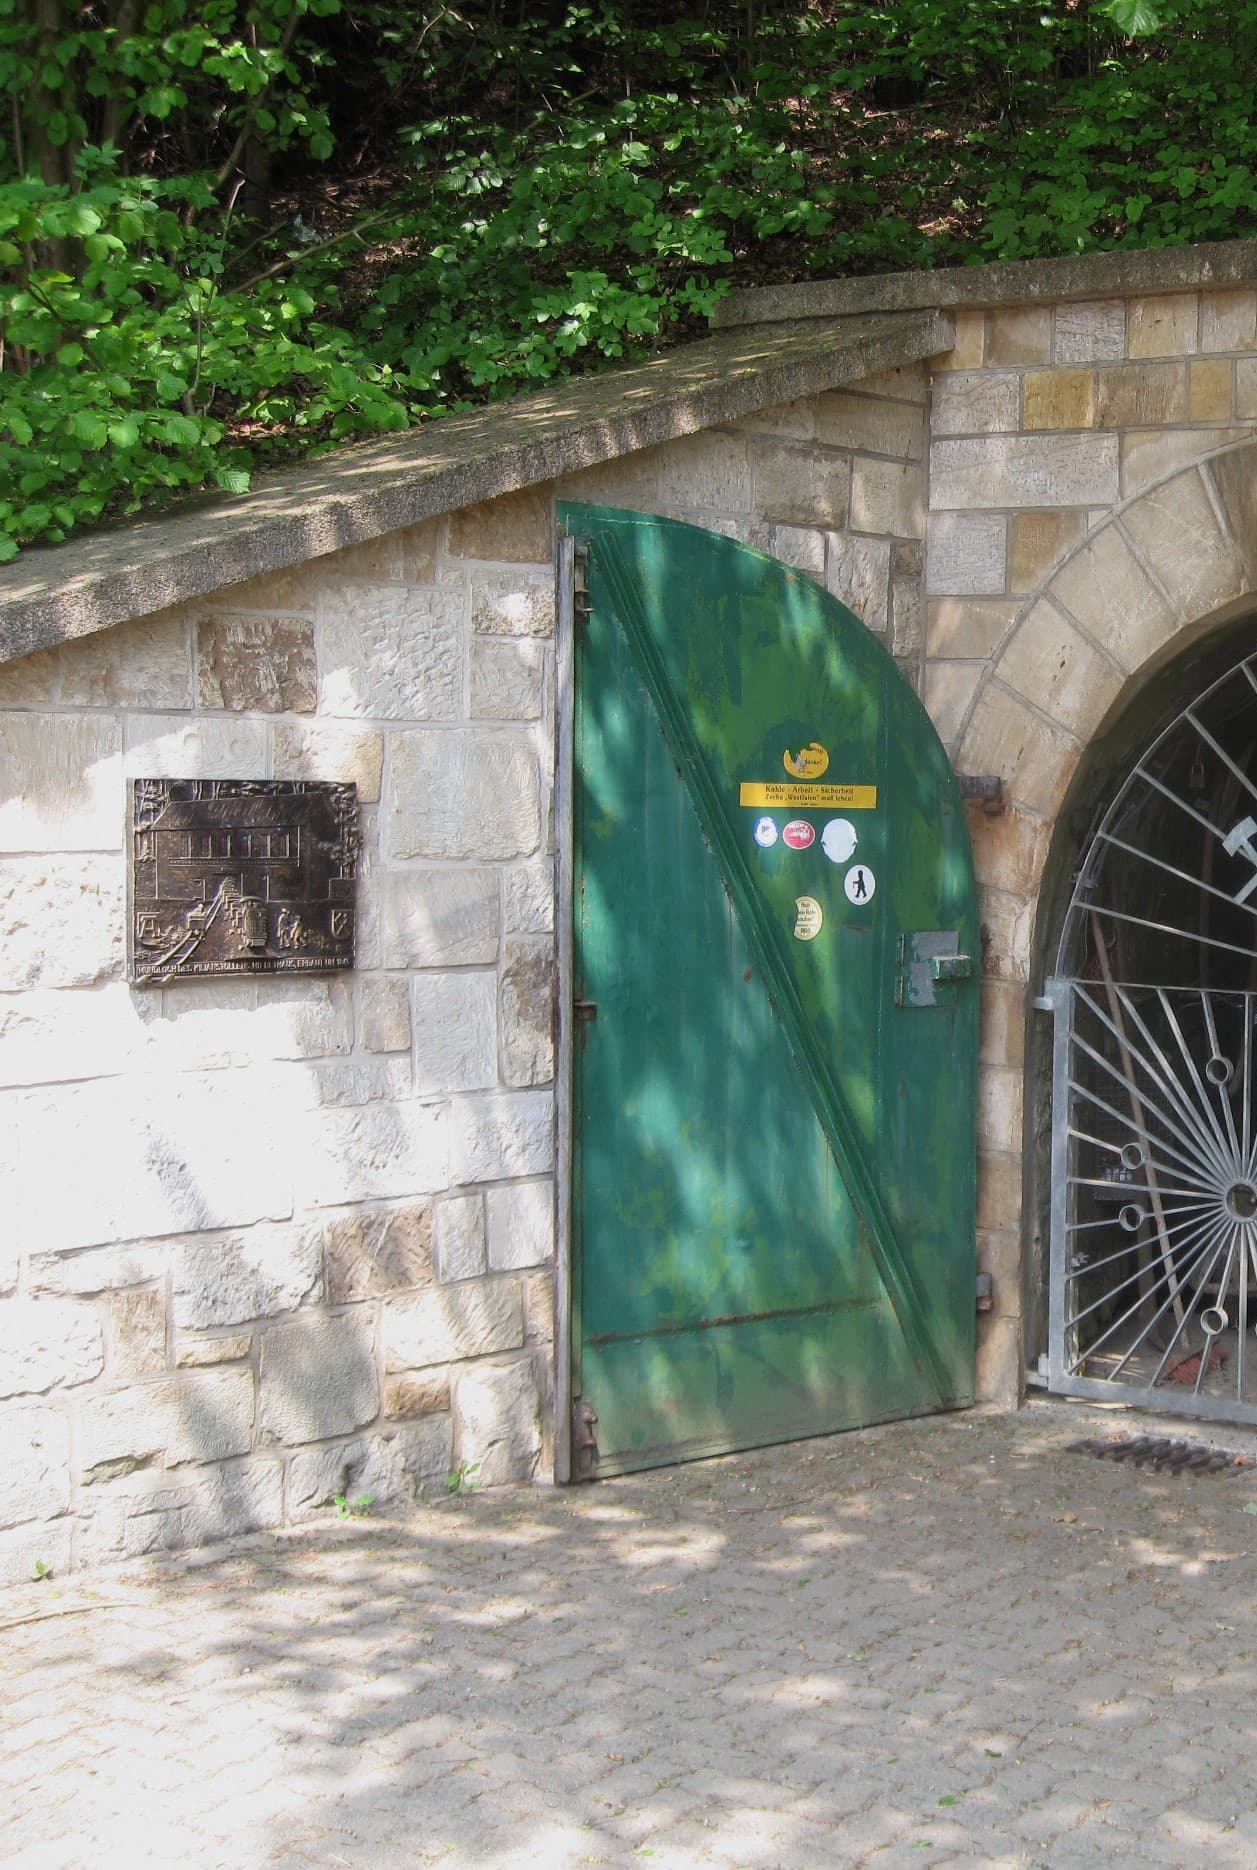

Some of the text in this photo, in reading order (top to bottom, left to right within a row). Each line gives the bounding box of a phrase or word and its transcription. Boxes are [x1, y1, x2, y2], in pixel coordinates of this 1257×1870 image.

[765, 785, 785, 793] Kohle
[820, 786, 854, 794] Sicherheit
[765, 793, 783, 801] Zeche
